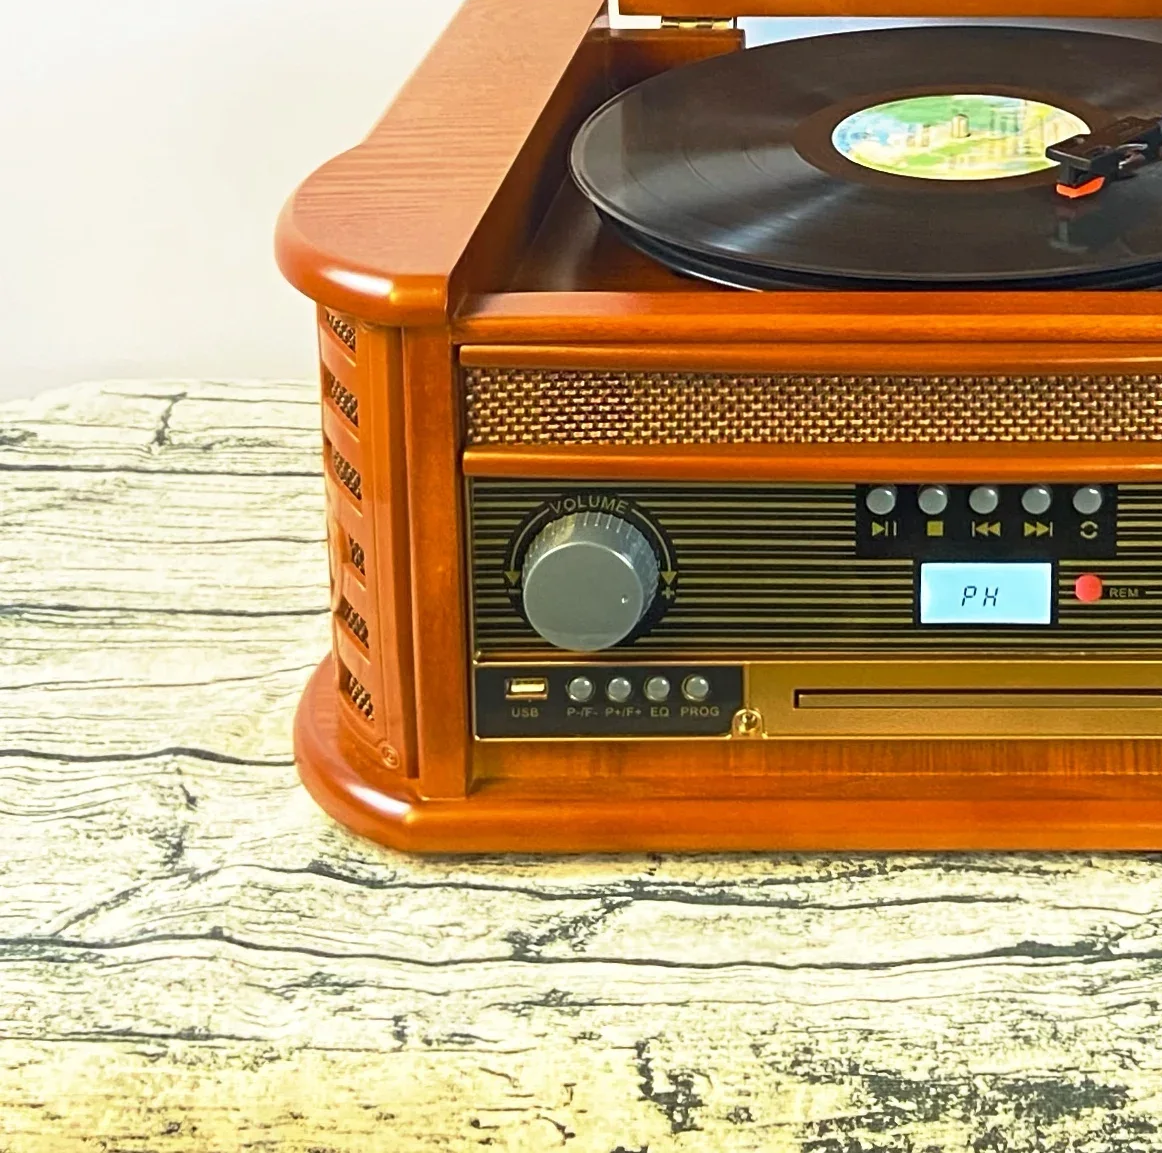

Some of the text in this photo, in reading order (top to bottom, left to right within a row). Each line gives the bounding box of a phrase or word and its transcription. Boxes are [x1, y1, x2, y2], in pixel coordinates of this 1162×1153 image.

[549, 495, 629, 515] VOLUME
[961, 586, 999, 607] PH
[1109, 588, 1139, 598] REM
[512, 708, 539, 718] USB
[566, 707, 598, 718] P-/F-
[605, 707, 642, 718] P+/F+
[650, 707, 670, 718] EQ
[680, 706, 719, 717] PROG
